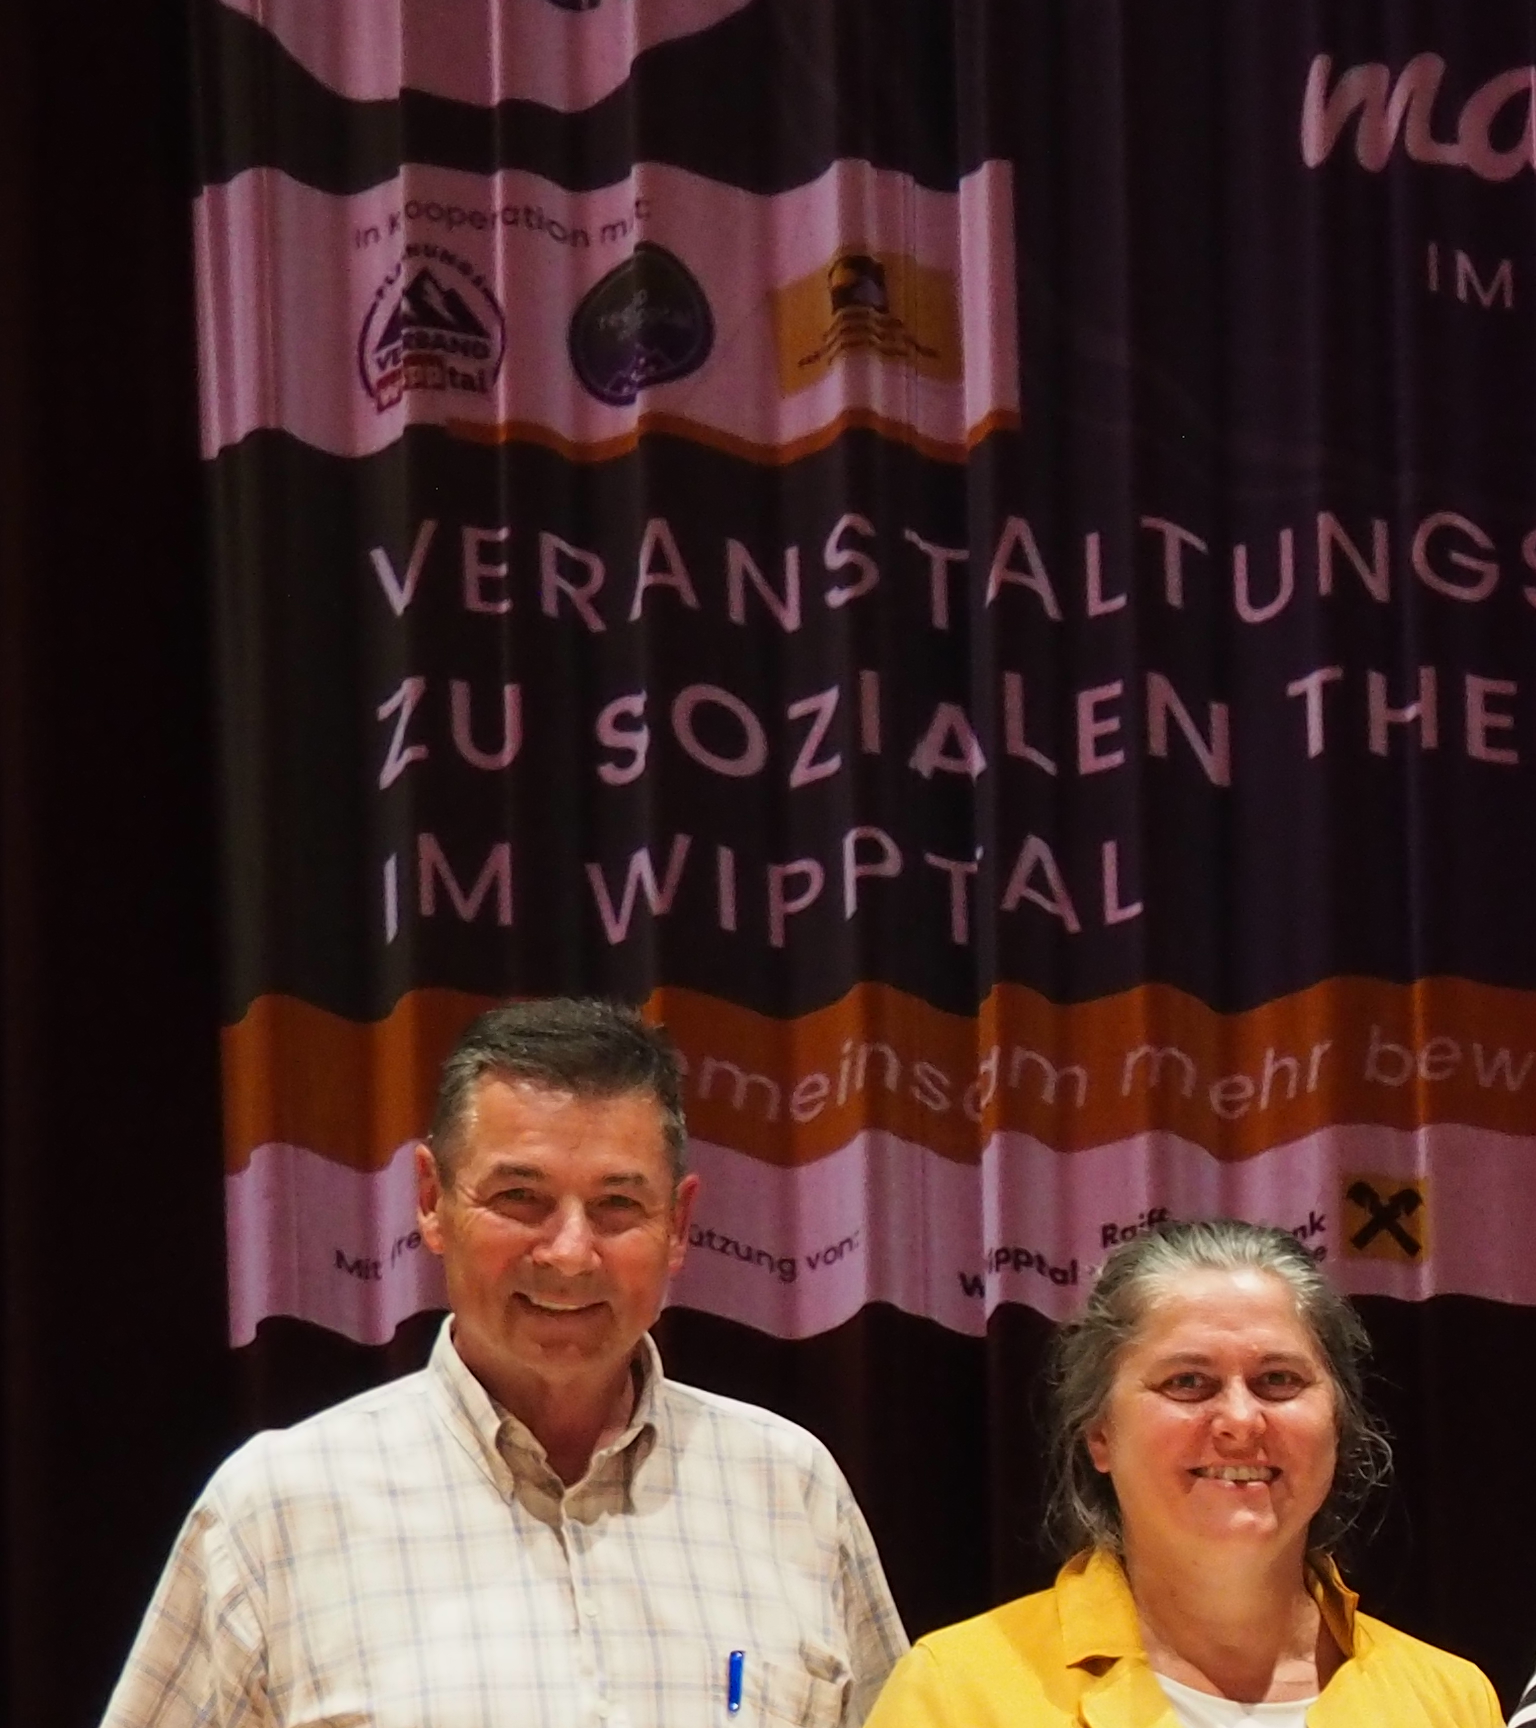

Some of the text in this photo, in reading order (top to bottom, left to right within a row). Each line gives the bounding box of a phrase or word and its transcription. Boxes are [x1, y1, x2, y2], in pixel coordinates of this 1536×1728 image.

[1427, 242, 1515, 310] IM
[376, 676, 524, 790] ZU
[596, 668, 1233, 789] SOZIALEN
[383, 825, 1144, 948] IM WIPPTAL
[675, 1036, 1088, 1126] meinsam
[1120, 1037, 1332, 1120] mehr
[334, 1249, 383, 1281] Mit
[958, 1246, 1079, 1299] Wipptal
